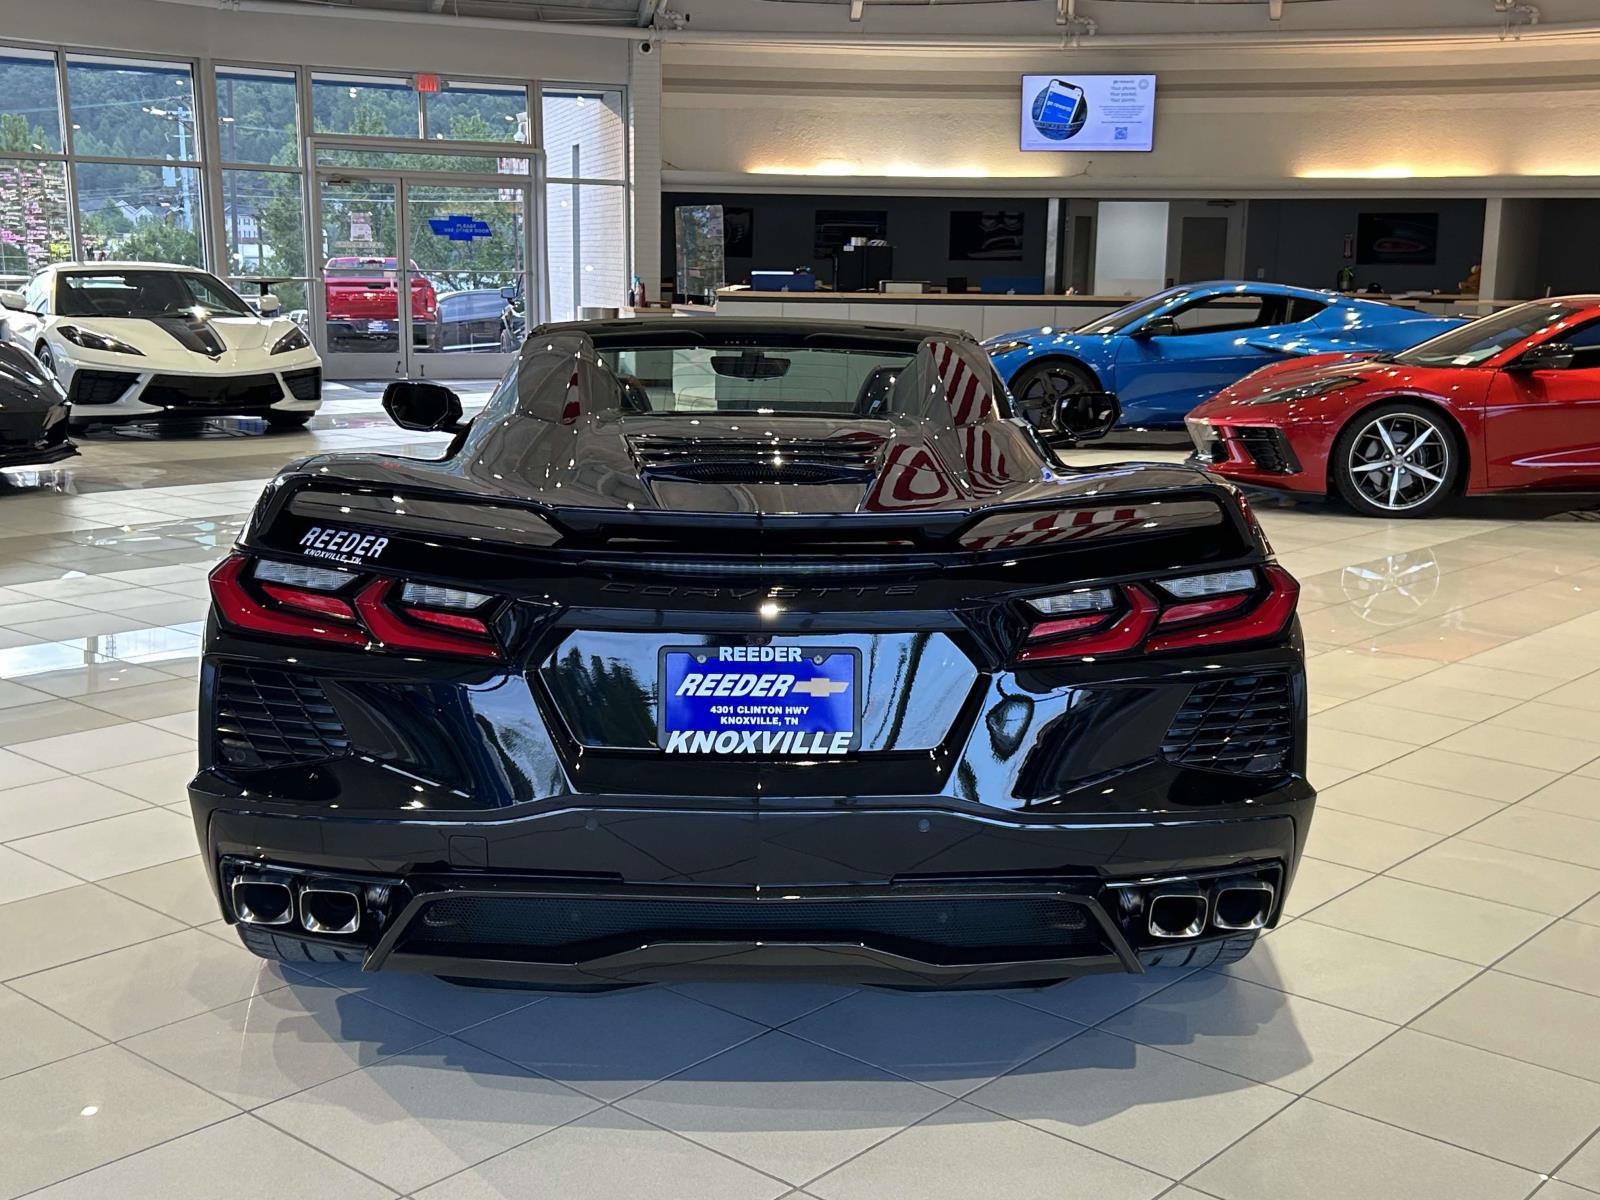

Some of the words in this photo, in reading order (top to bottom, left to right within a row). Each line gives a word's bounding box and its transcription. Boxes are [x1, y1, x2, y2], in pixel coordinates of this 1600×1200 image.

[418, 79, 437, 91] EXIT
[299, 526, 389, 559] REEDER
[303, 548, 348, 563] KNOXVILLE,
[599, 582, 922, 600] CORVETTE
[719, 646, 802, 662] REEDER
[675, 673, 796, 697] REEDER
[710, 705, 734, 714] 4301
[737, 705, 782, 714] CLINTON
[785, 706, 809, 714] HWY
[720, 716, 782, 726] KNOXVILLE,
[784, 717, 799, 725] TN
[665, 730, 854, 755] KNOXVILLE
